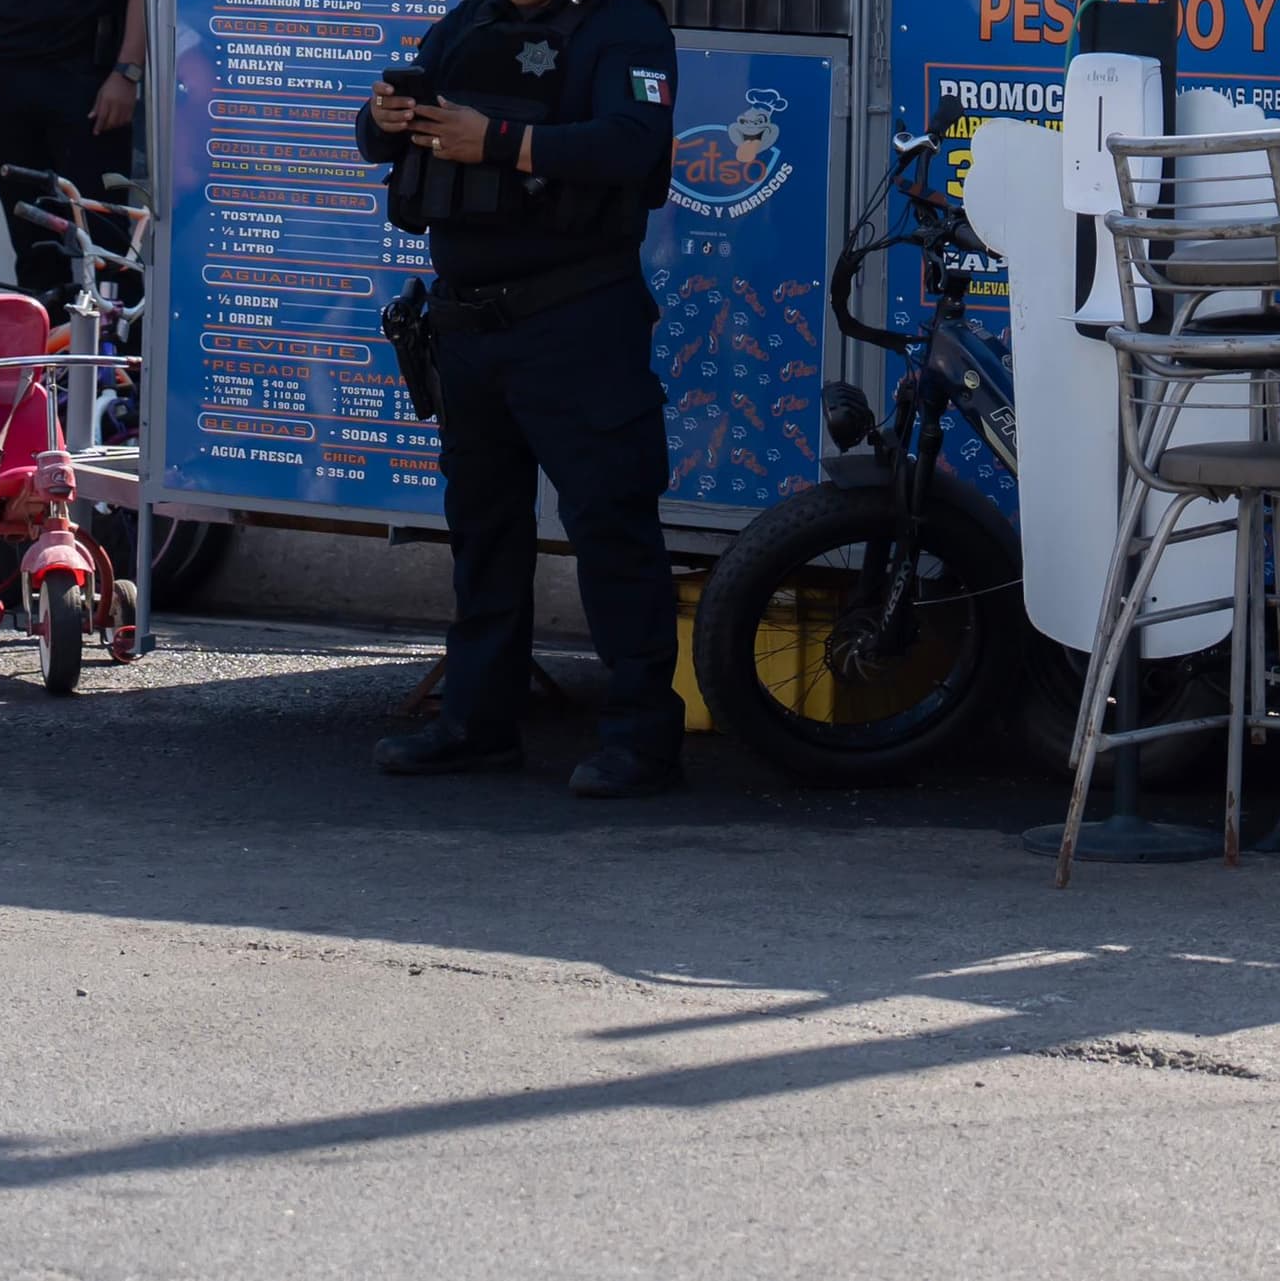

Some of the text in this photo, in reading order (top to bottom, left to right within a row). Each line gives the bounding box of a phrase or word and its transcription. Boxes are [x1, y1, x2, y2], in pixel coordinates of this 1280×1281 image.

[323, 0, 361, 10] PULPO
[405, 4, 447, 15] 75.00
[215, 20, 376, 37] TACOS CON QUESO
[227, 42, 372, 61] CAMARÓN ENCHILADO
[228, 58, 283, 71] MARLYN
[238, 75, 333, 89] QUESO EXTRA
[939, 79, 1064, 113] PROMOC
[217, 103, 257, 115] SOPA
[263, 106, 282, 117] DE
[211, 142, 293, 157] POZOLE DE
[671, 136, 767, 185] Fatso
[212, 161, 365, 177] SOLO LOS DOMINGOS
[212, 187, 367, 208] ENSALADA DE SIERRA
[715, 206, 723, 218] Y
[728, 162, 793, 219] MARISCOS
[221, 211, 283, 224] TOSTADA
[239, 228, 280, 239] LITRO
[234, 243, 274, 254] LITRO
[221, 270, 352, 289] AGUACHILE
[235, 295, 279, 308] ORDEN
[229, 312, 273, 326] ORDEN
[214, 337, 356, 358] CEVICHE
[212, 375, 254, 386] TOSTADA
[204, 418, 307, 436] BEBIDAS
[342, 429, 388, 443] SODAS
[211, 445, 303, 464] AGUA FRESCA
[323, 452, 440, 471] CHICA GRAND
[328, 467, 437, 487] 35.00 55.00
